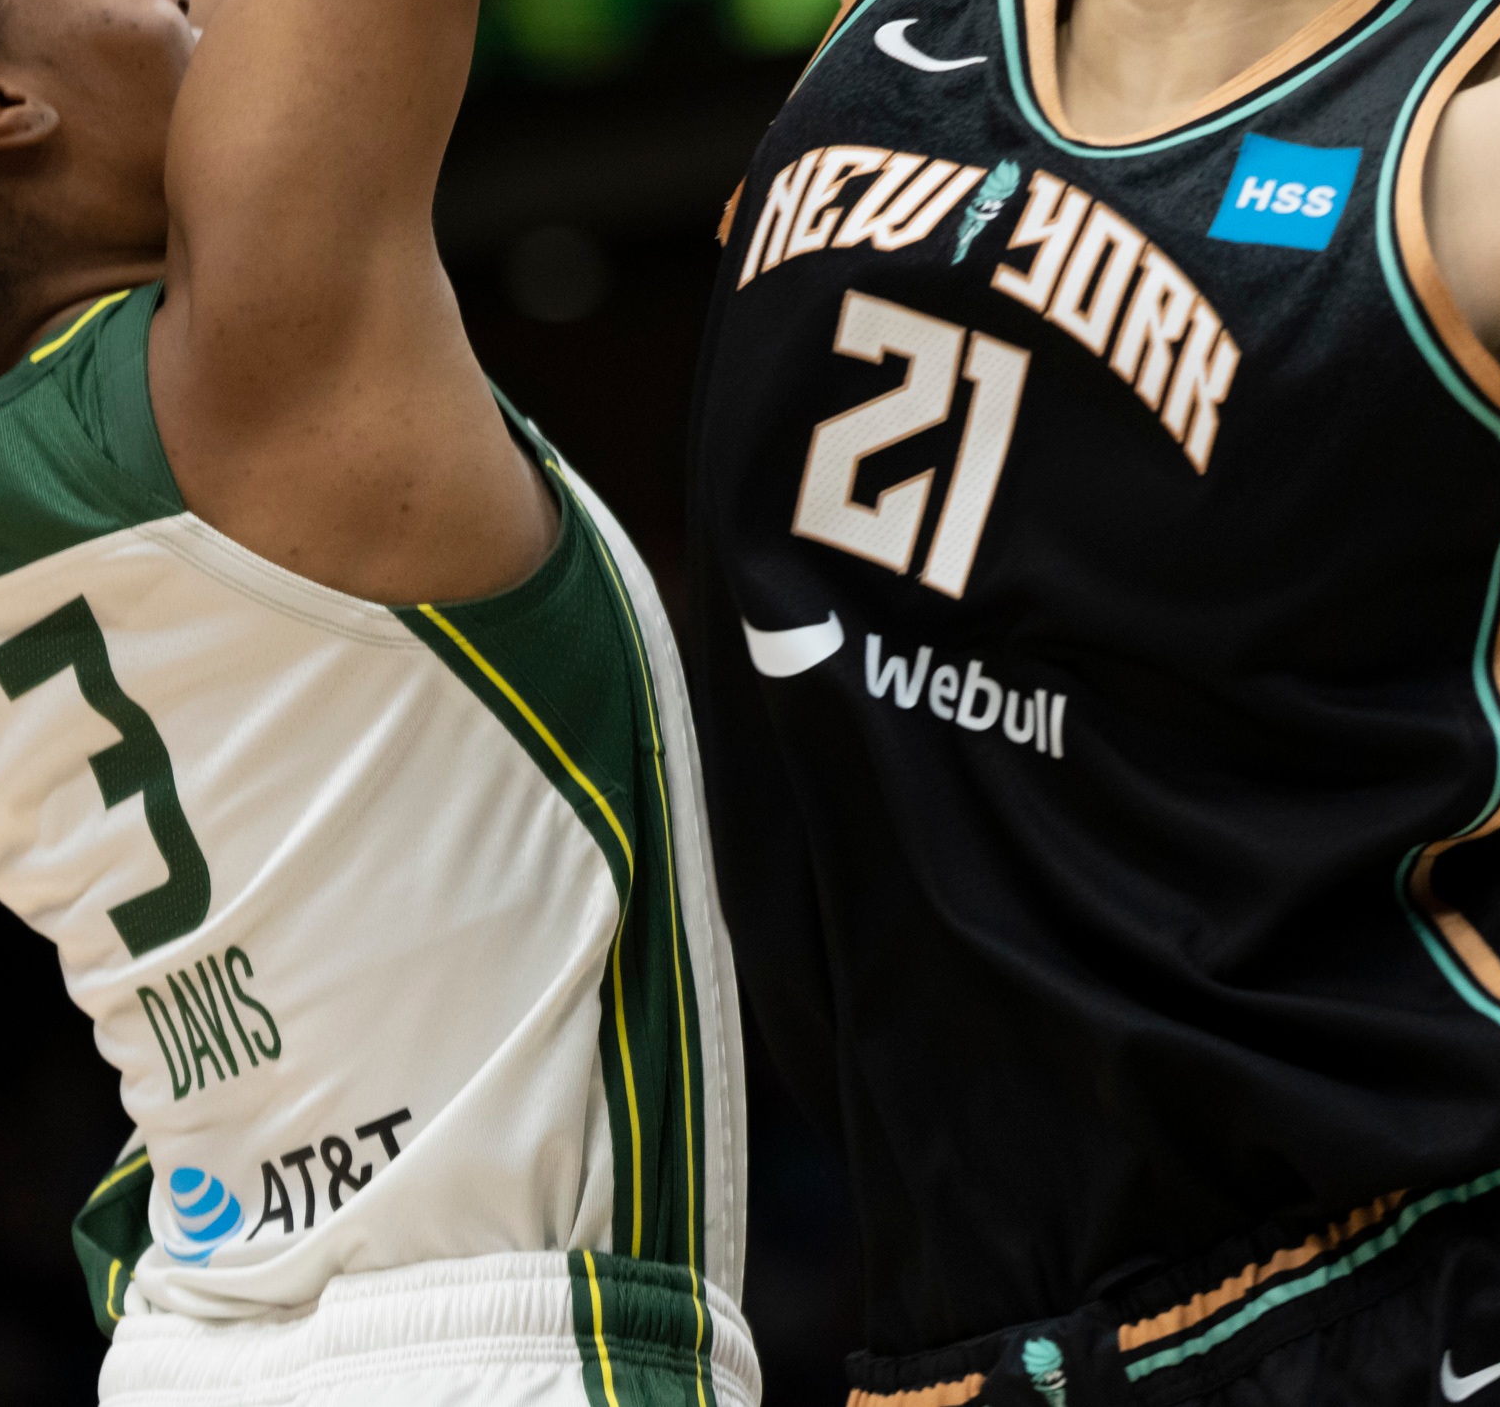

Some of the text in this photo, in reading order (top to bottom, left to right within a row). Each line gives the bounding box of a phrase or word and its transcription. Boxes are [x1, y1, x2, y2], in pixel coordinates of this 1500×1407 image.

[1236, 174, 1337, 218] HSS
[736, 145, 1241, 475] NEW YORK
[791, 288, 1032, 600] 21
[864, 632, 1067, 758] Webull
[136, 945, 281, 1101] DAVIS
[245, 1106, 412, 1242] AT&T
